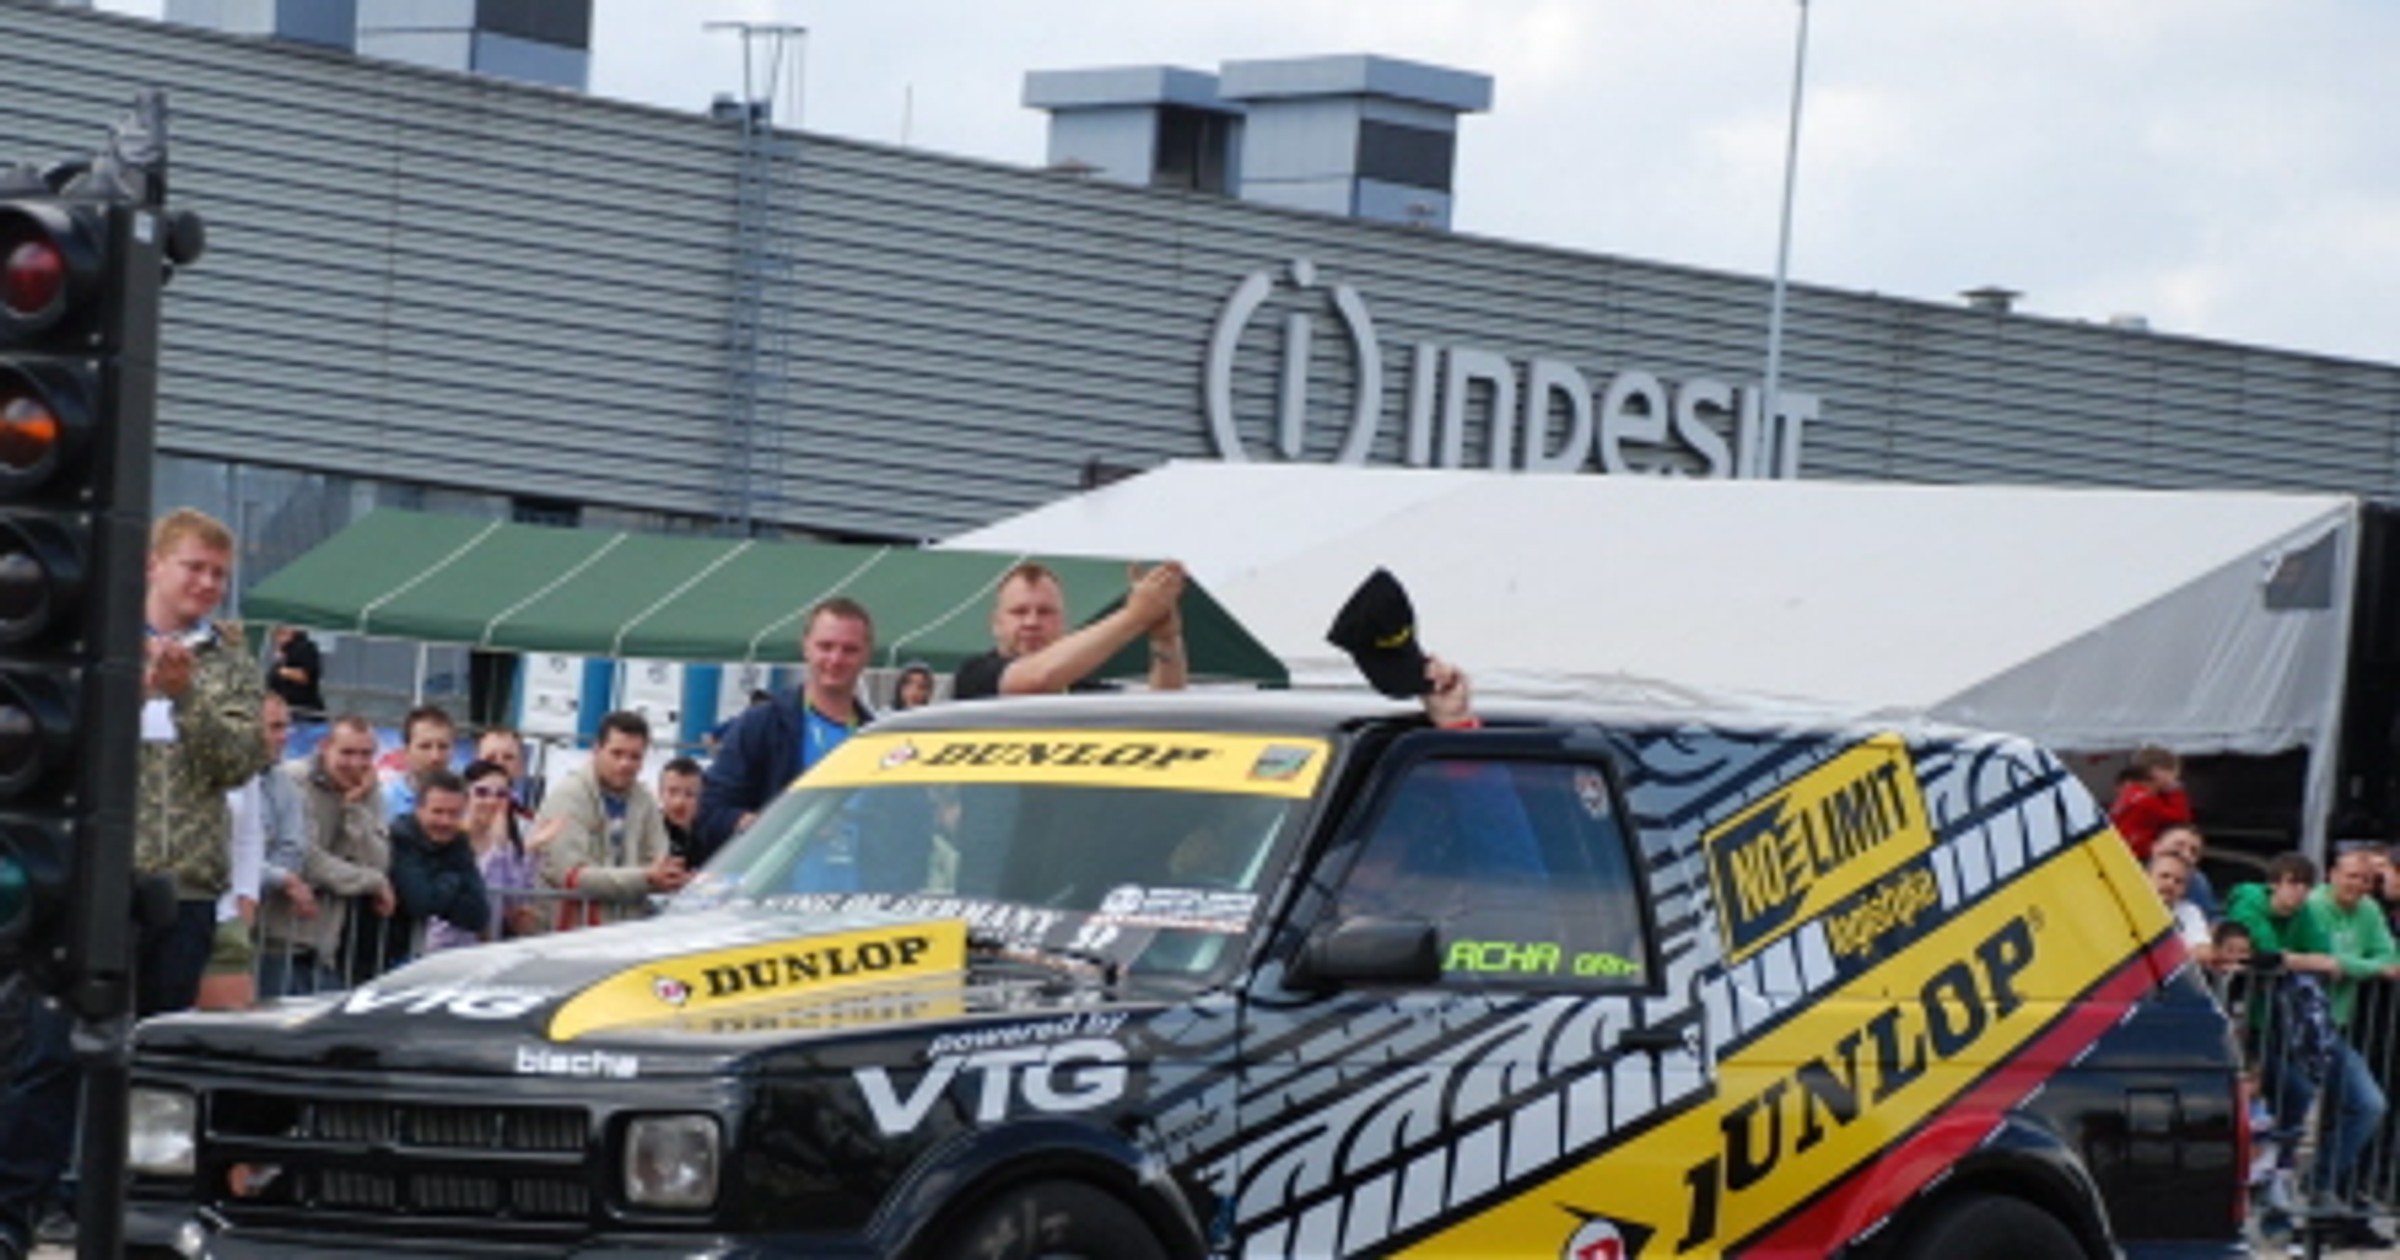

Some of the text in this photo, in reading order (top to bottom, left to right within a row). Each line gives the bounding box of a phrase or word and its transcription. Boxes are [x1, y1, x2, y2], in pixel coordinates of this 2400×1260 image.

[921, 742, 1213, 769] DUNLOP
[1800, 761, 1909, 879] LIMIT
[703, 934, 930, 998] DUNLOP
[927, 1010, 1129, 1057] powered by
[853, 1038, 1130, 1136] VTG
